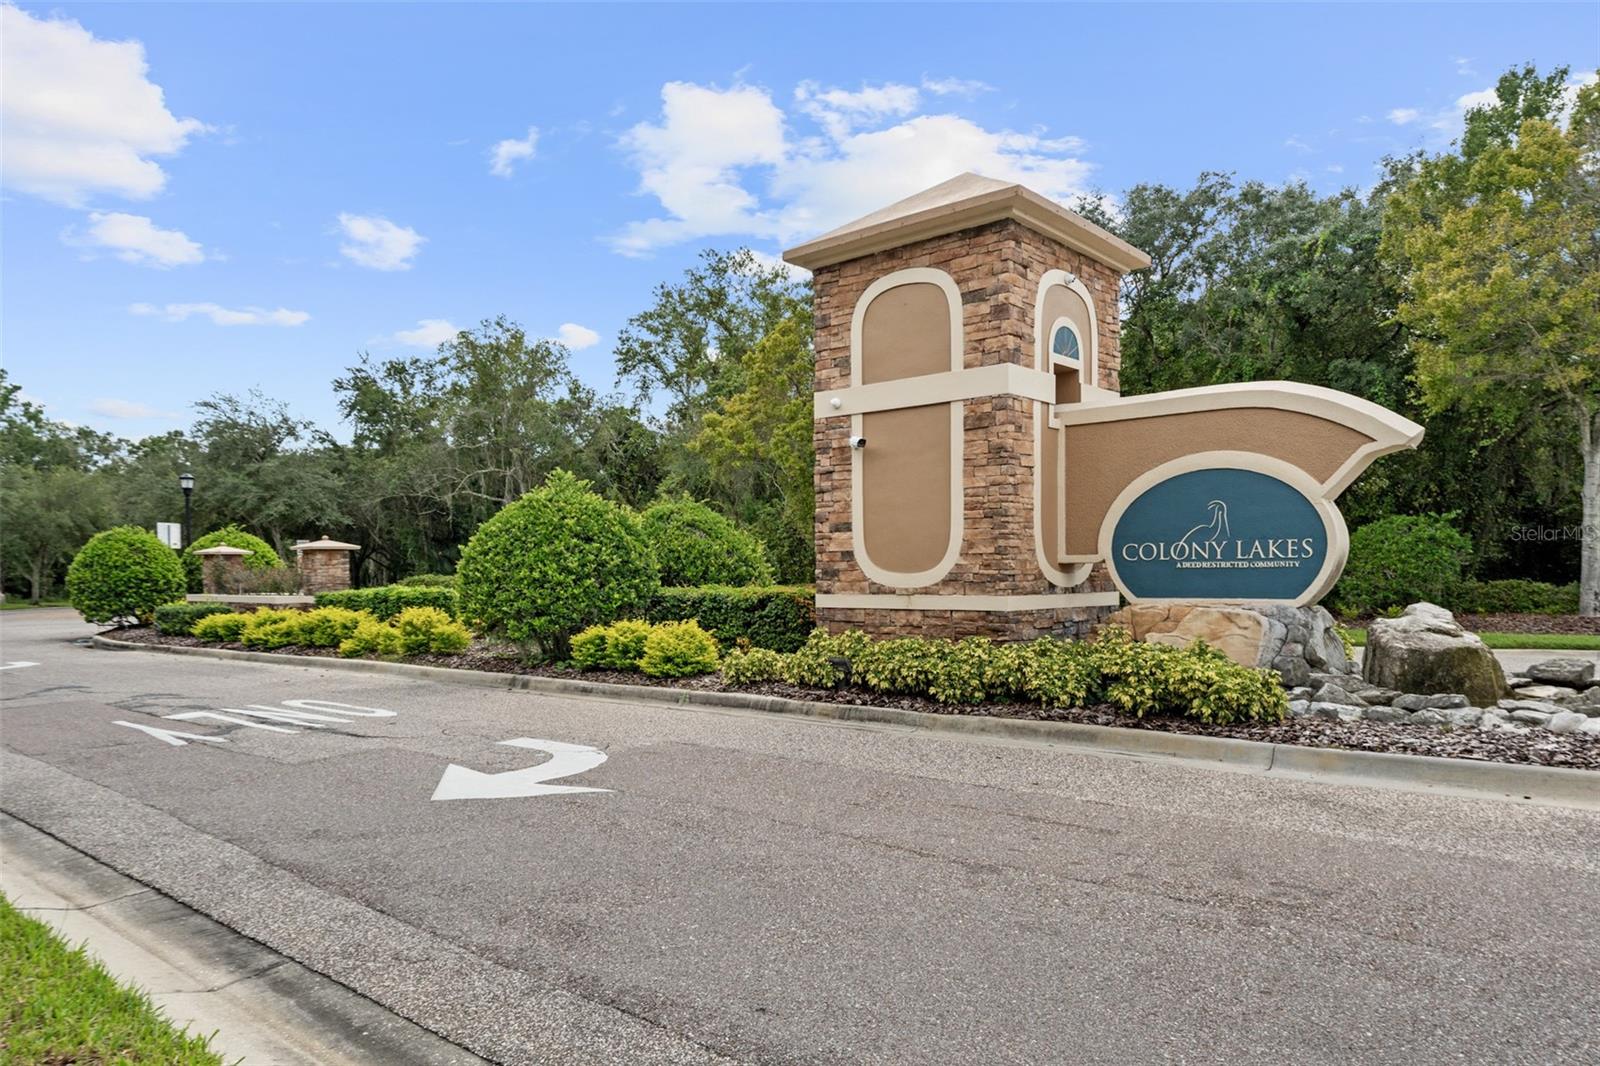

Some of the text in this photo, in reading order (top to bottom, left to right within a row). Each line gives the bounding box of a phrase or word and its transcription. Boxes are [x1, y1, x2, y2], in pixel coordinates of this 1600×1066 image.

[1122, 538, 1313, 561] COLONY LAKES
[1182, 561, 1201, 569] DEED
[1202, 561, 1249, 569] RESTRICTED
[1250, 560, 1300, 568] COMMUNITY
